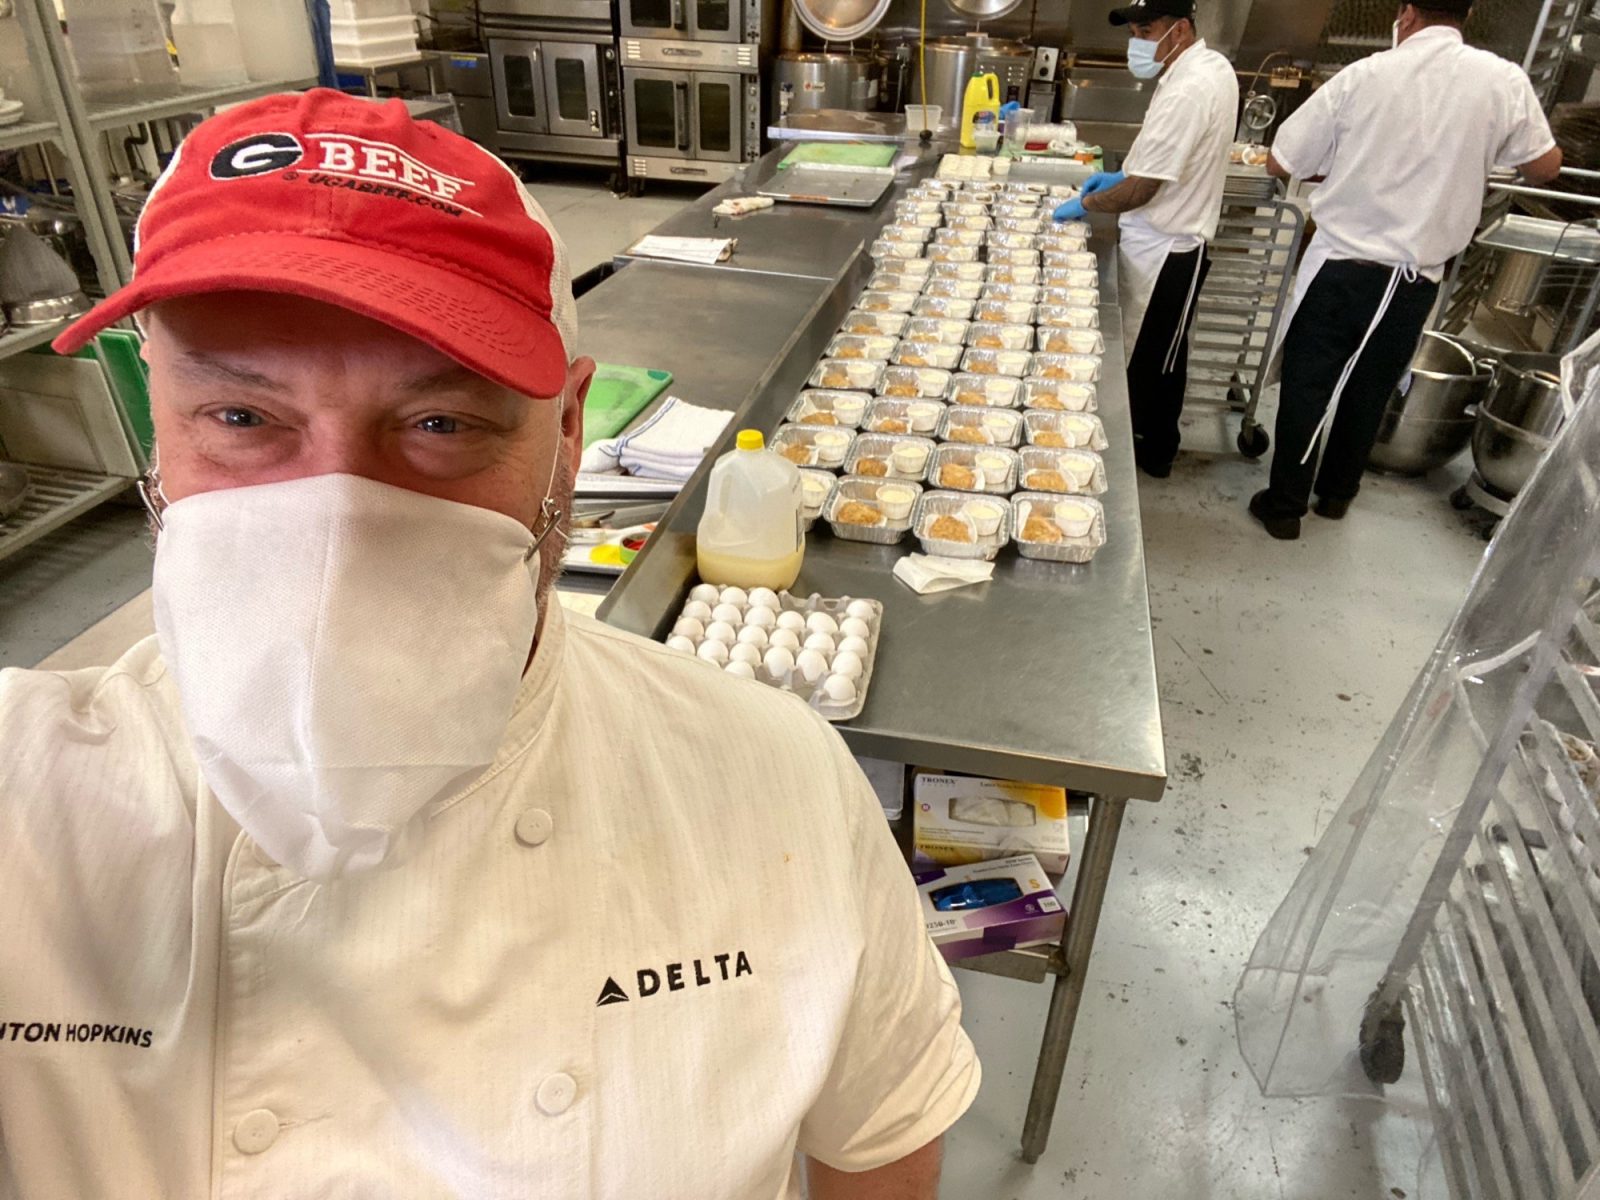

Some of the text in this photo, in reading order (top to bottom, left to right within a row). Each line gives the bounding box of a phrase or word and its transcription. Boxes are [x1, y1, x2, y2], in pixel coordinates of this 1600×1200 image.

[209, 132, 303, 180] G
[318, 141, 462, 199] BEEF
[308, 173, 463, 216] UGABEEF.COM
[922, 777, 956, 785] TRONEX
[1029, 879, 1041, 889] S
[636, 950, 753, 998] DELTA
[66, 1023, 153, 1048] HOPKINS
